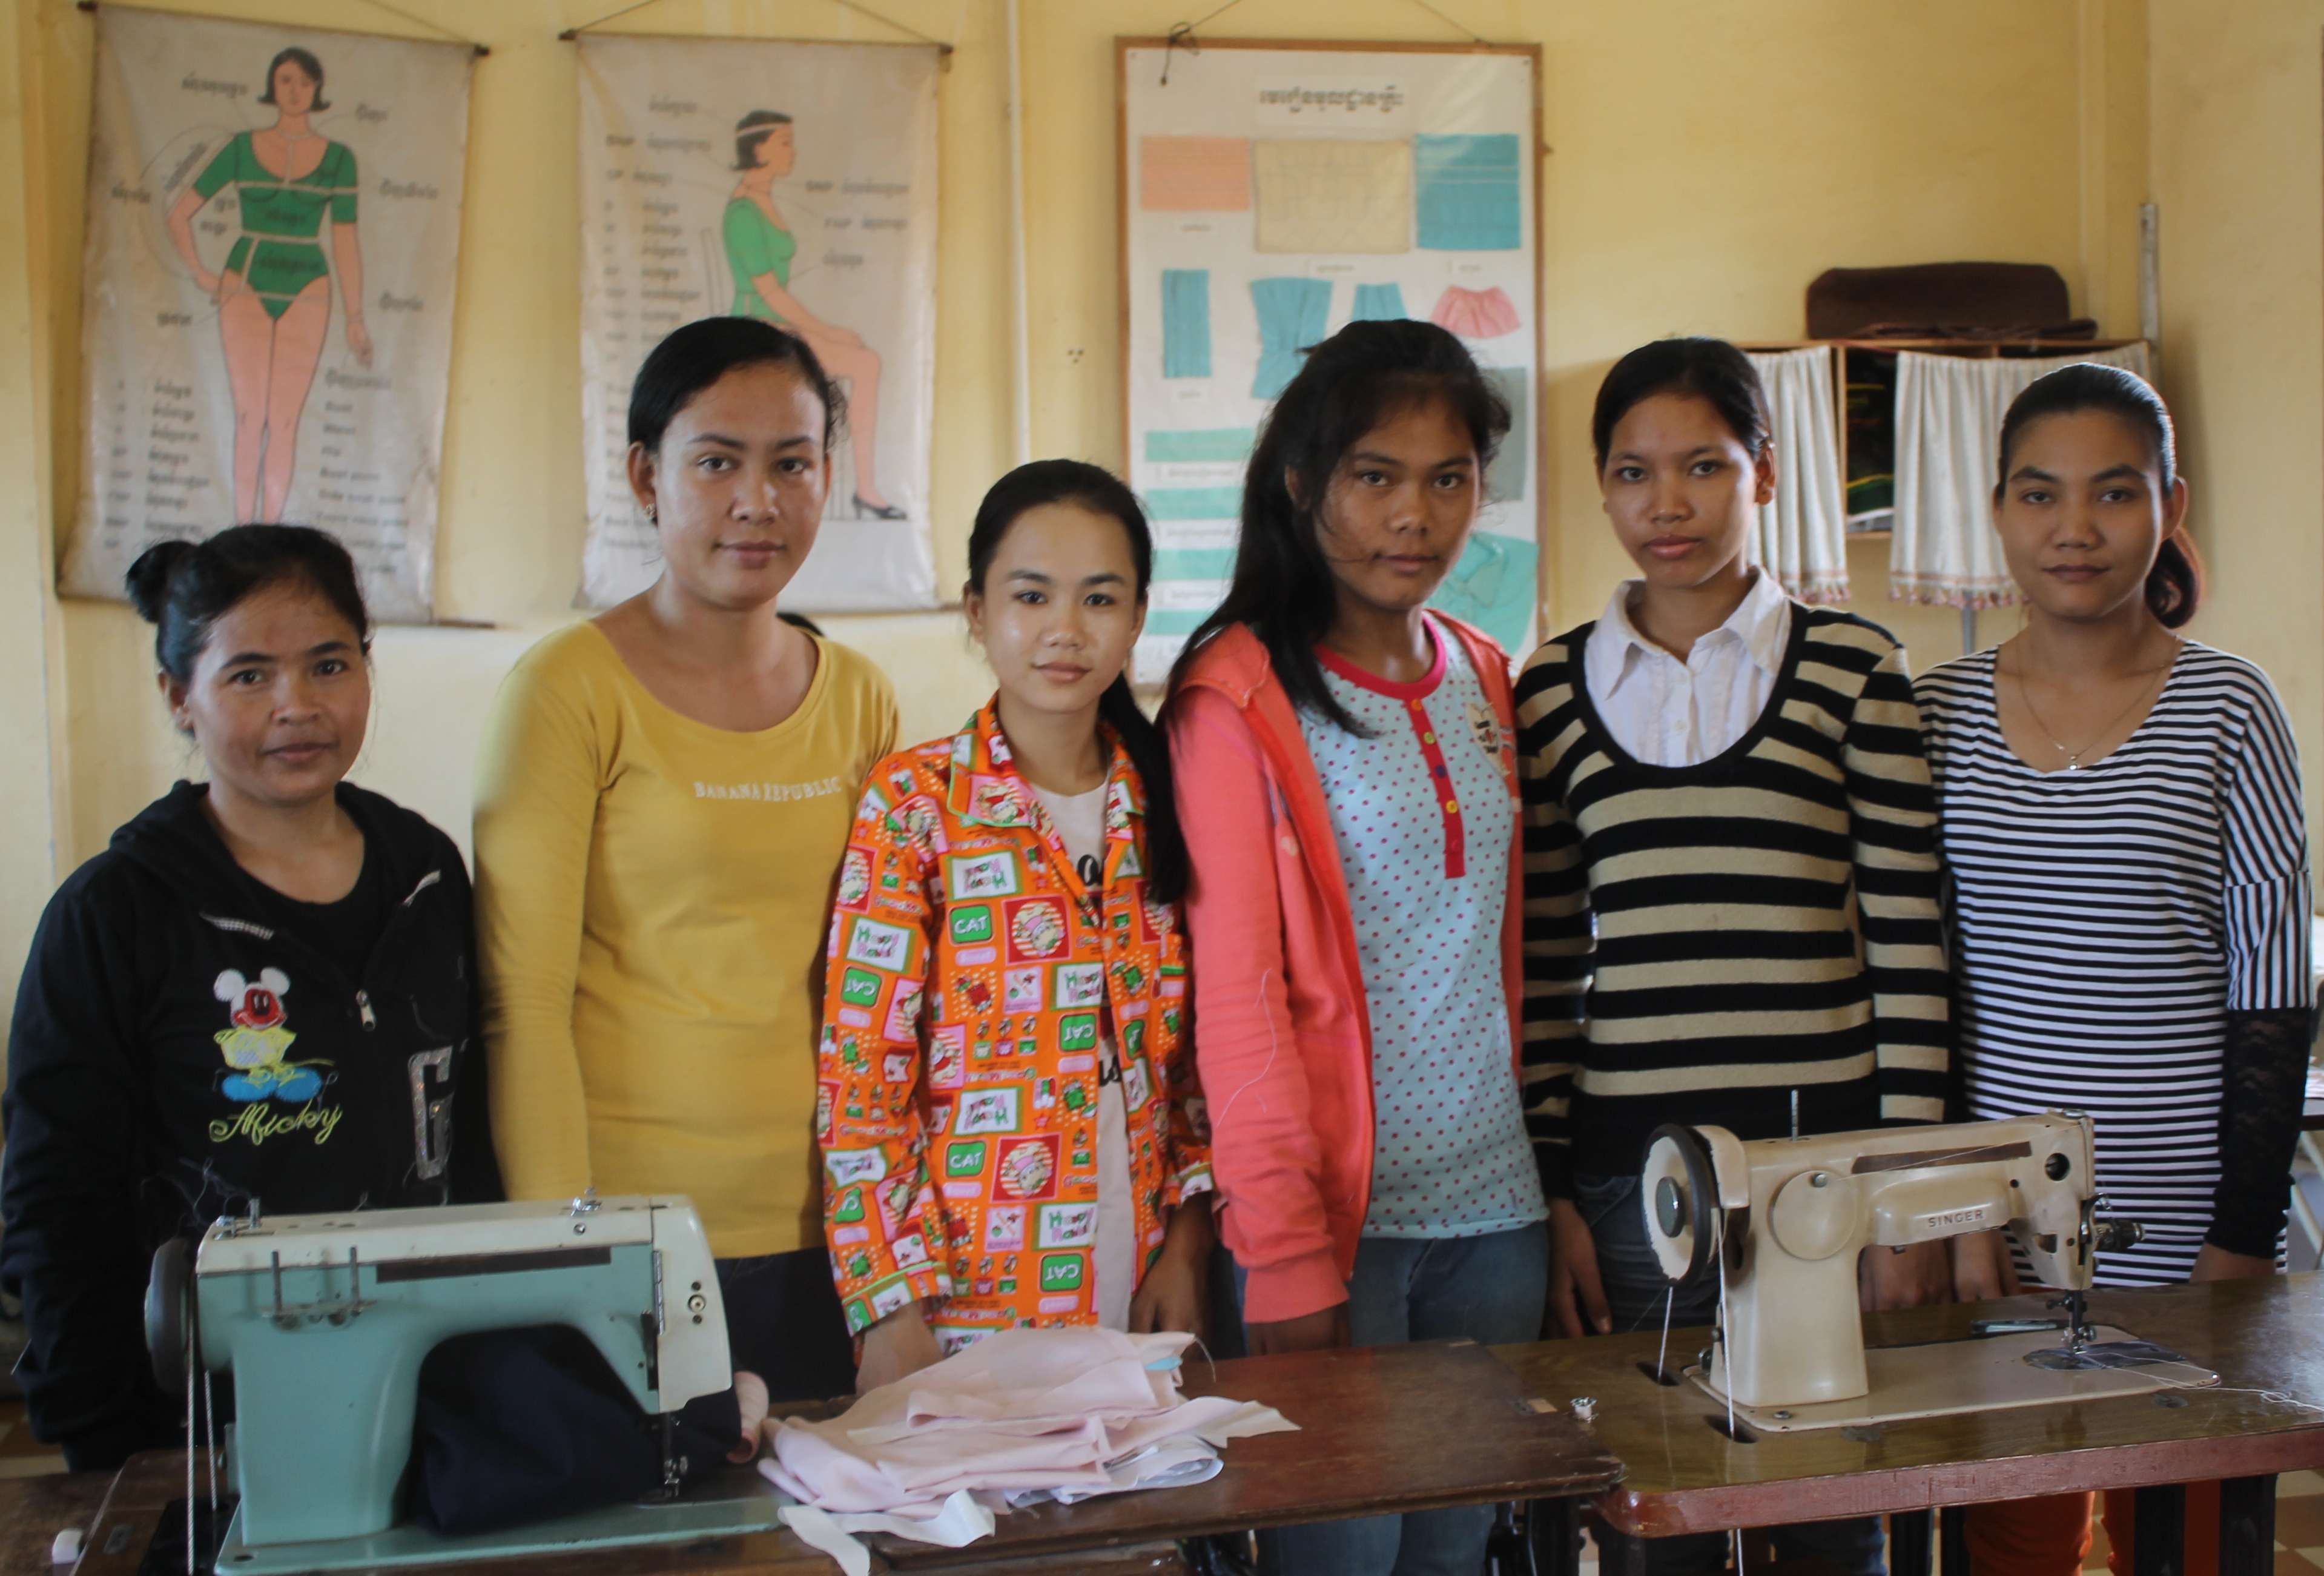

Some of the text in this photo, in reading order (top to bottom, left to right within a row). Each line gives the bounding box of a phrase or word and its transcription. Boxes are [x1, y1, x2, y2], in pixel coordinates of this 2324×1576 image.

[954, 915, 989, 934] CAT
[949, 1151, 984, 1168] CAT
[1927, 1210, 1984, 1228] SINGER
[1045, 1263, 1080, 1281] CAT
